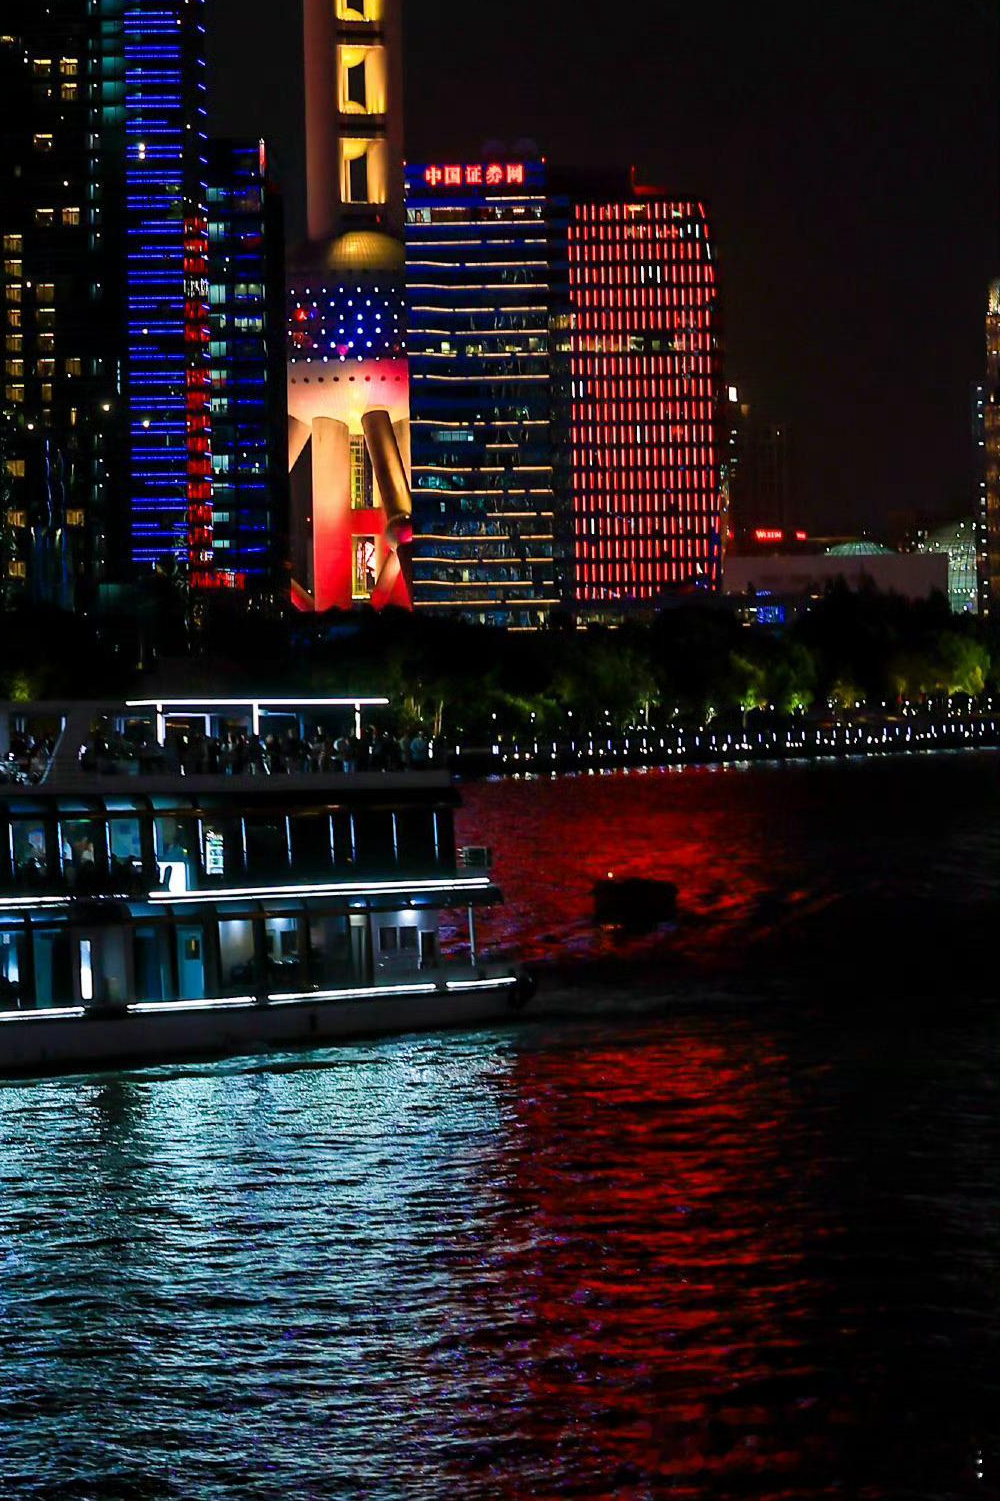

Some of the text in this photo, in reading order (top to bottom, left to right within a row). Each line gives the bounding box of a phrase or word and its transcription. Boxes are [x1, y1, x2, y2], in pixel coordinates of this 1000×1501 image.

[425, 164, 524, 186] 中国证券网
